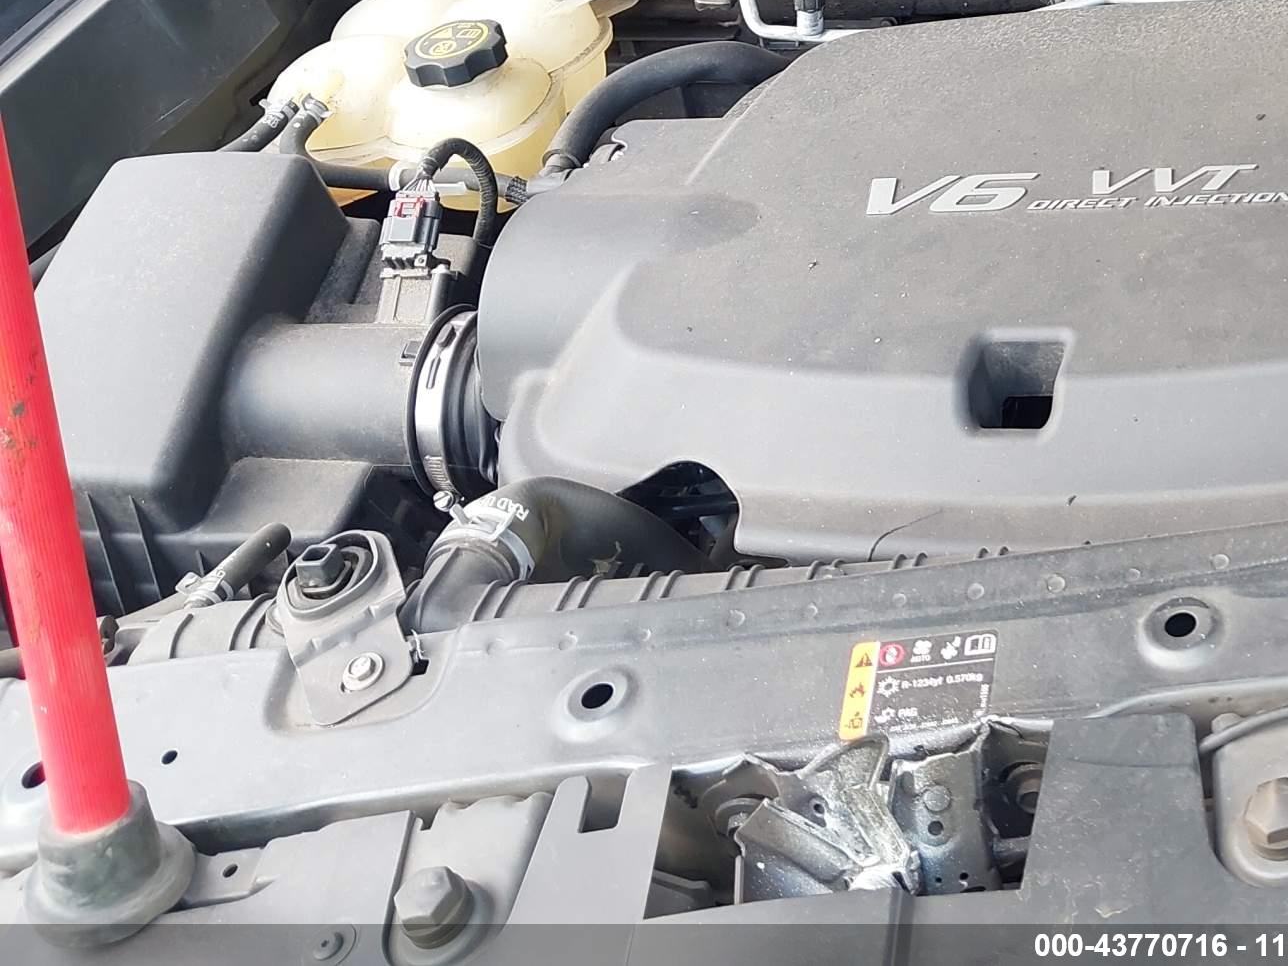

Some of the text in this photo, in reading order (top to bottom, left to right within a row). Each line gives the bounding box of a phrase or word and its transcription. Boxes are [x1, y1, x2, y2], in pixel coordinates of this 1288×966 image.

[1091, 163, 1259, 195] VVT
[865, 172, 1041, 216] V6
[1027, 195, 1138, 211] DIRECT
[496, 497, 530, 522] RAD
[901, 676, 945, 689] R-1234yf
